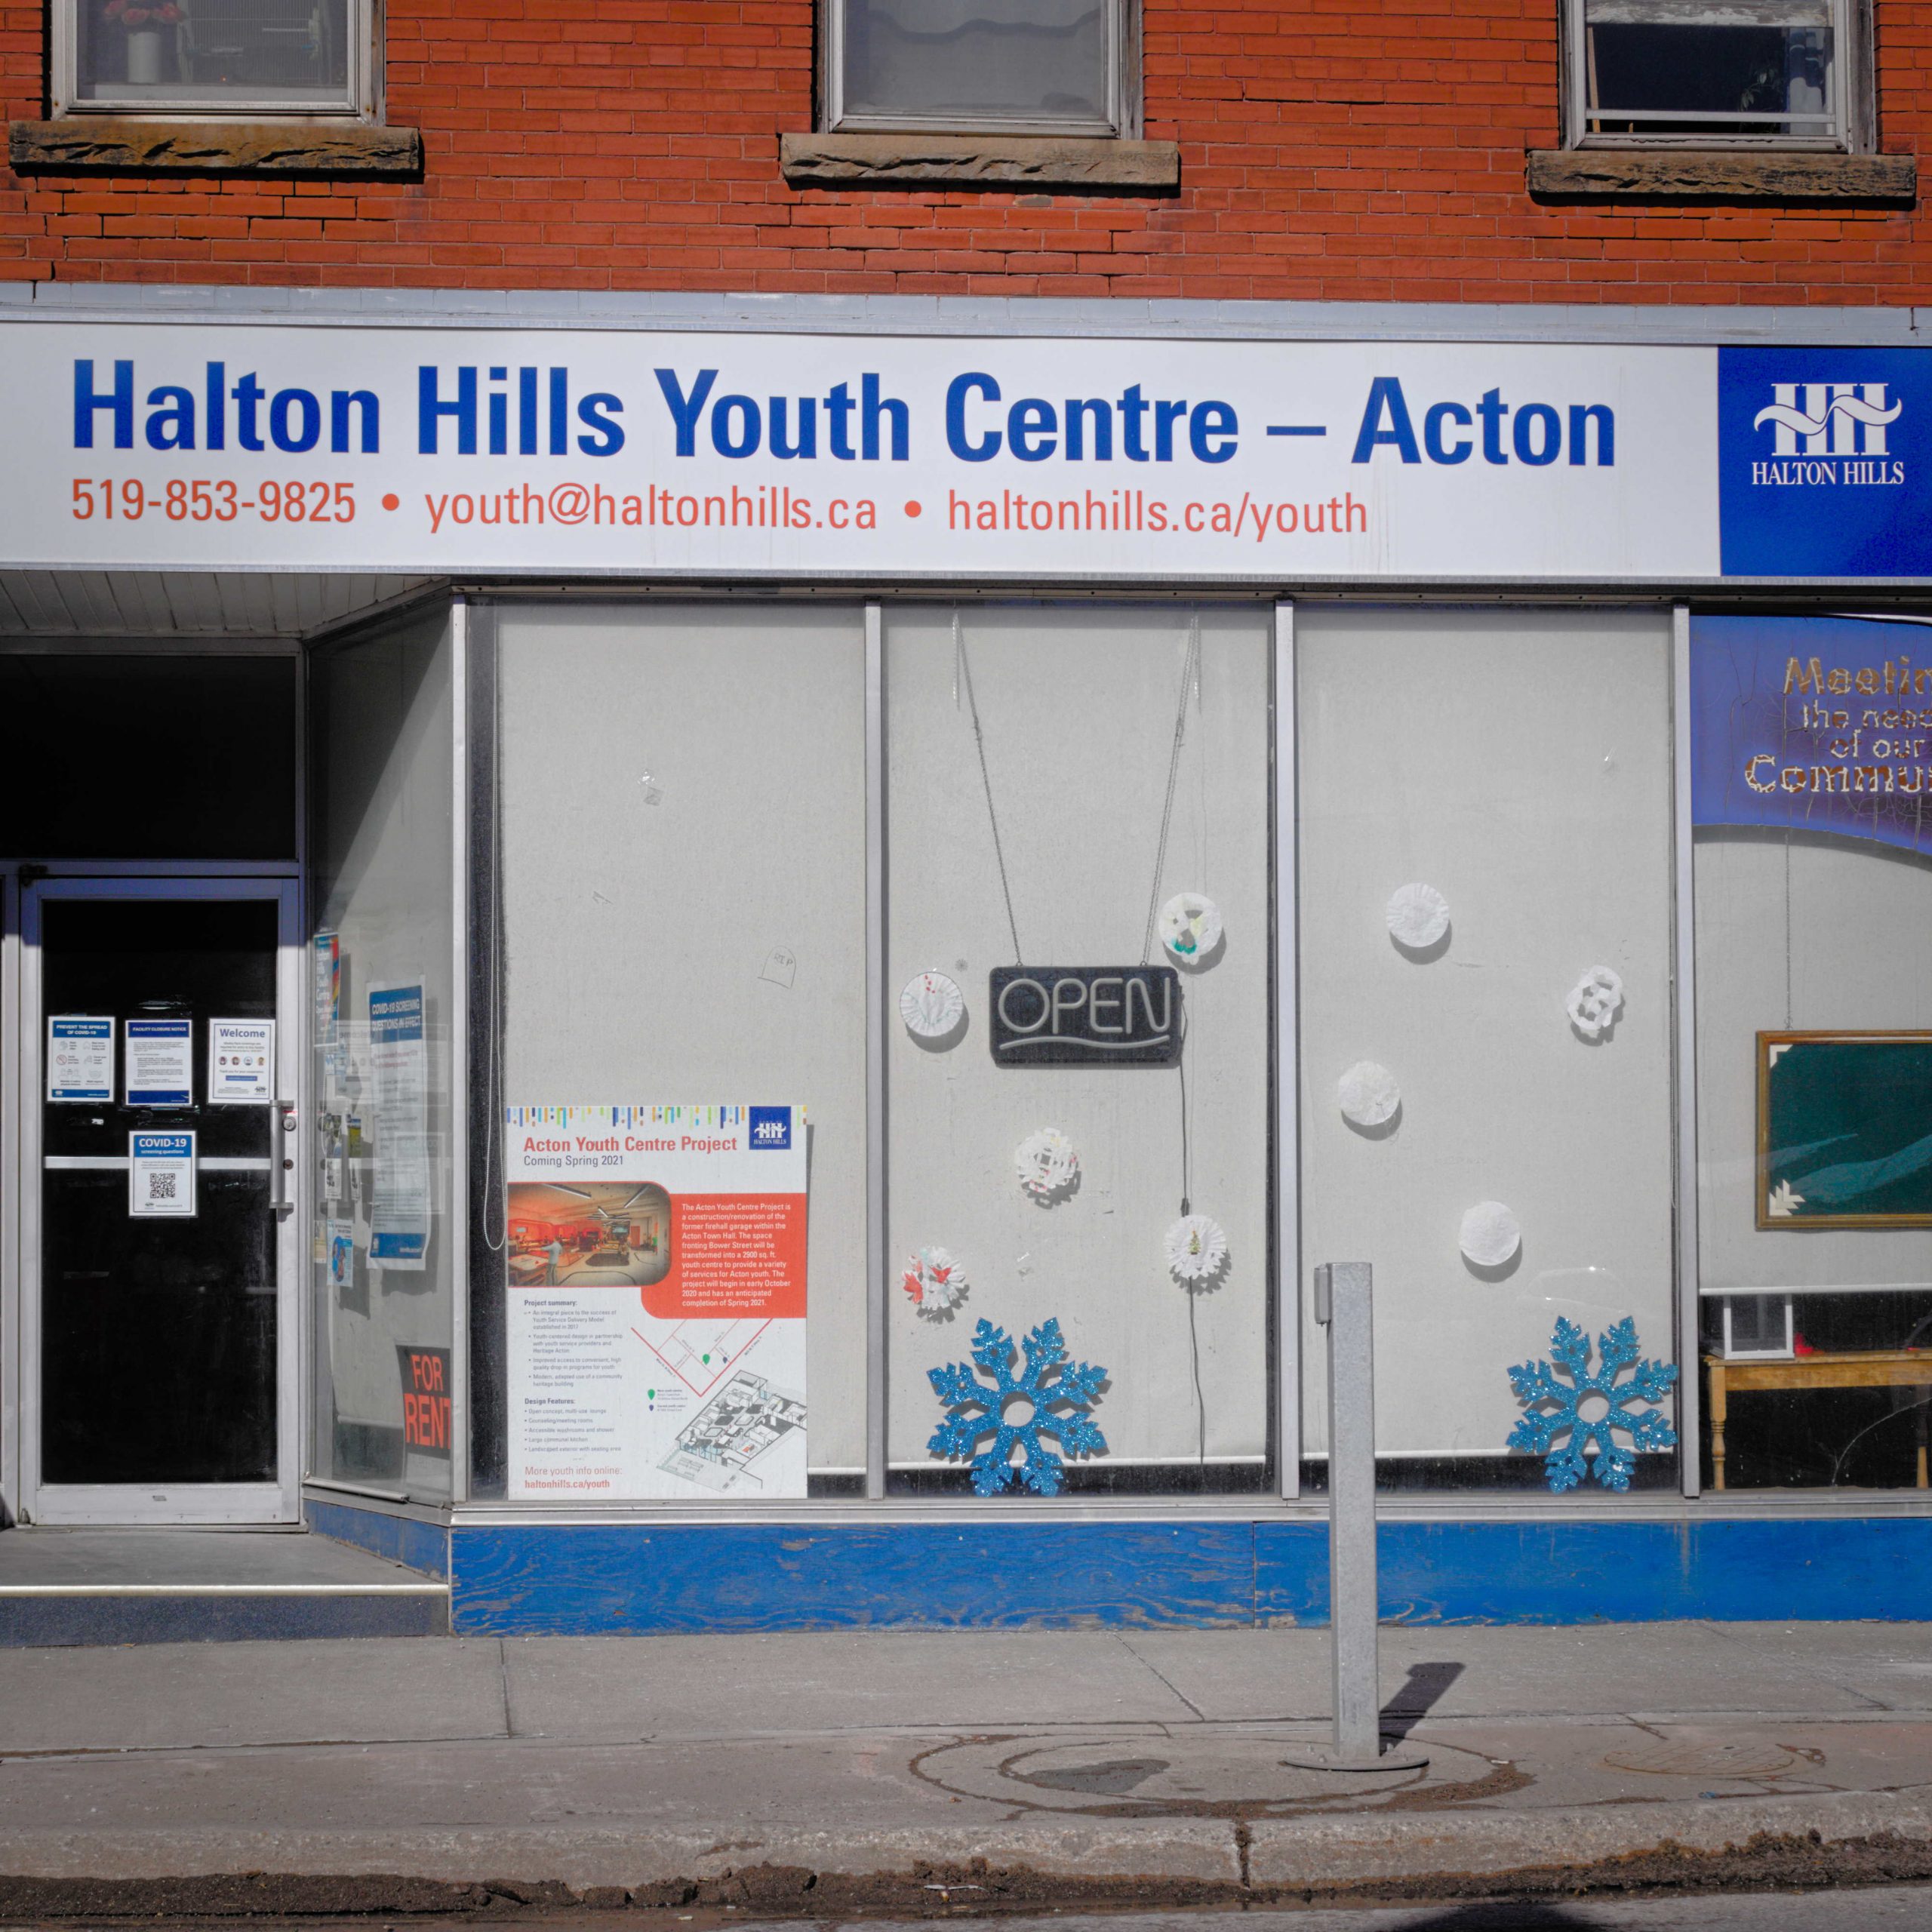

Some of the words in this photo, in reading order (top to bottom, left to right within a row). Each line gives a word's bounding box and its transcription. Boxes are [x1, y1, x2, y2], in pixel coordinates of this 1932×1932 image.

[75, 359, 378, 453] Halton
[420, 366, 623, 457] Hills
[655, 369, 908, 460] Youth
[946, 373, 1237, 463] Centre
[1353, 377, 1614, 466] Acton
[1752, 462, 1836, 485] HALTON
[1844, 462, 1904, 485] HILLS
[72, 478, 355, 523] 519-853-9825
[425, 483, 875, 534] youth@haltonhills.ca
[949, 490, 1366, 542] haltonhills.ca/youth
[1801, 700, 1848, 728] the
[1829, 729, 1861, 758] of
[1872, 740, 1925, 758] our
[1745, 755, 1932, 792] Commu
[998, 977, 1171, 1033] OPEN
[220, 1029, 266, 1038] Welcome
[139, 1138, 187, 1147] COVID-19
[524, 1137, 571, 1152] Acton
[576, 1137, 619, 1152] Youth
[625, 1136, 675, 1152] Centre
[681, 1136, 737, 1155] Project
[524, 1155, 562, 1168] Coming
[565, 1155, 598, 1168] Spring
[601, 1155, 623, 1165] 2021
[760, 1203, 784, 1211] Project
[738, 1231, 752, 1239] The
[681, 1242, 708, 1251] fronting
[681, 1261, 700, 1269] youth
[750, 1270, 771, 1278] youth.
[719, 1280, 738, 1288] begin
[735, 1289, 772, 1297] anticipated
[728, 1299, 749, 1308] Spring
[411, 1355, 443, 1390] FOR
[525, 1398, 546, 1406] Design
[405, 1393, 451, 1449] RENT
[525, 1466, 548, 1475] More
[550, 1466, 574, 1477] youth
[576, 1466, 592, 1475] info
[594, 1466, 623, 1475] online:
[525, 1479, 610, 1490] haltonhills.ca/youth
